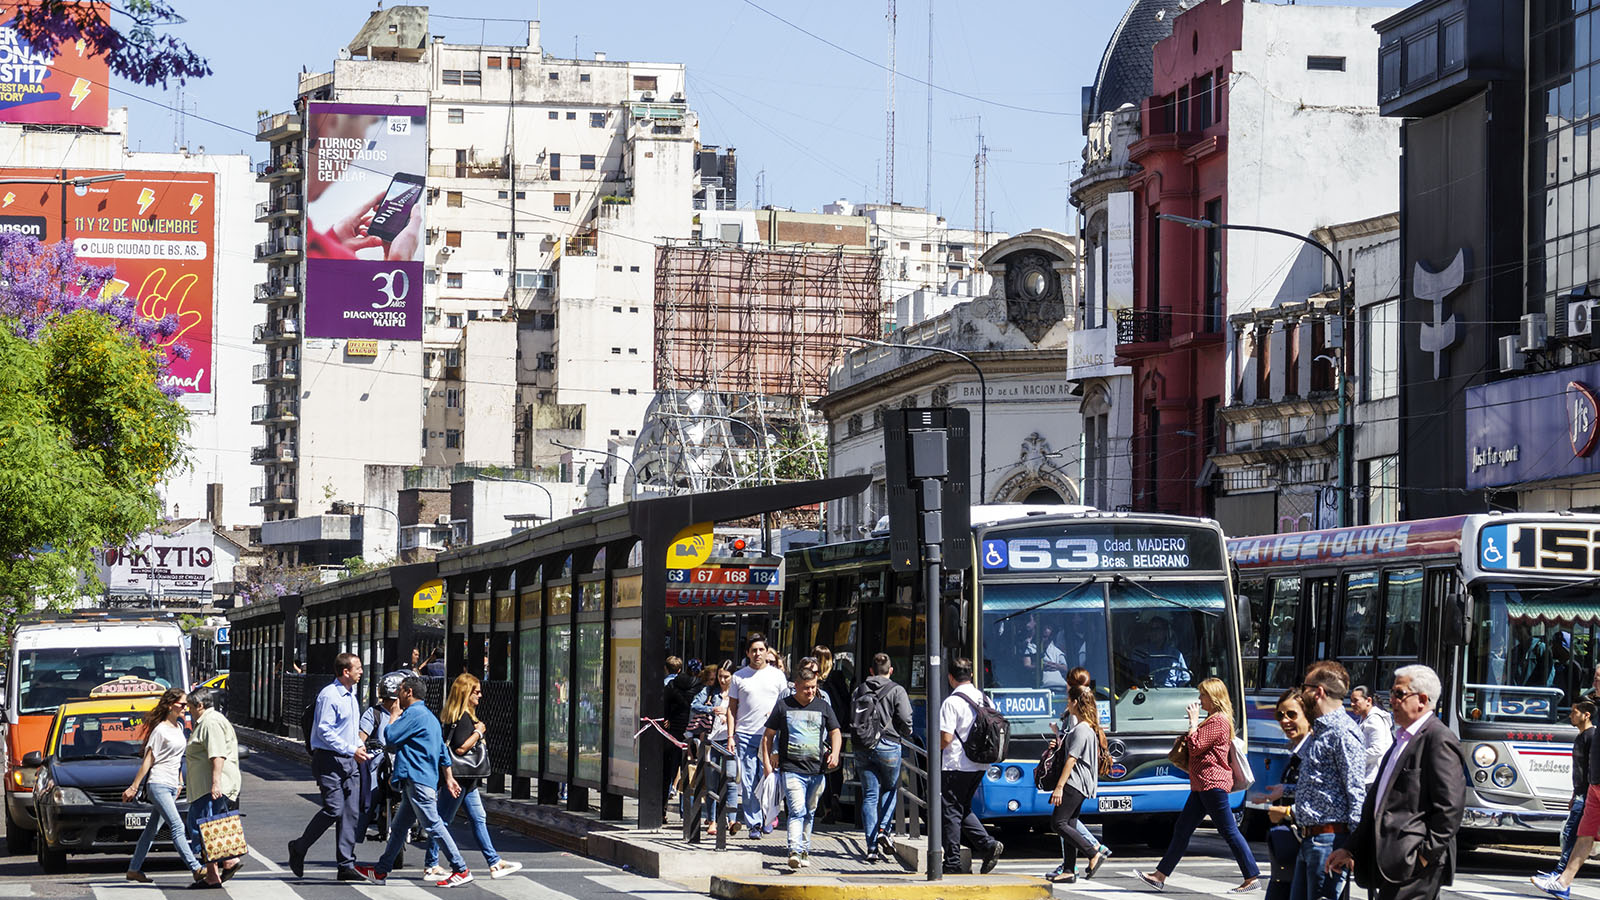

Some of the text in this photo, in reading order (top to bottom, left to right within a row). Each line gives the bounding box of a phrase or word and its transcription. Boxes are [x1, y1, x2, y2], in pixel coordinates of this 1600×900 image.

[17, 84, 43, 93] PARA
[391, 123, 407, 132] 457
[319, 137, 371, 149] TURNOS Y
[319, 149, 388, 160] RESULTADOS
[318, 160, 348, 171] EN TU
[318, 171, 366, 182] CELULAR
[0, 223, 40, 235] nson
[75, 217, 199, 234] 11 Y 12 DE NOVIEMBRE
[90, 242, 199, 257] CLUB CIUDAD DE BS. AS.
[371, 269, 409, 308] 30
[343, 311, 407, 320] DIAGNOSTICO
[373, 319, 406, 327] MAIPU
[1023, 384, 1056, 395] NACION
[1272, 534, 1322, 562] 152
[1330, 524, 1412, 558] OLIVOS
[1512, 526, 1600, 571] 15
[676, 543, 698, 557] BA
[1007, 538, 1186, 569] 63 Cdad. MADERO
[1101, 554, 1190, 568] Bcas. BELGRANO
[668, 570, 776, 583] 63 67 168 184
[419, 593, 433, 601] BA
[678, 589, 750, 604] OLIVOS
[101, 682, 157, 693] PORTEÑO
[1006, 697, 1046, 713] PAGOLA
[1487, 697, 1550, 714] 152
[1156, 766, 1169, 776] 104
[1117, 800, 1131, 809] 152
